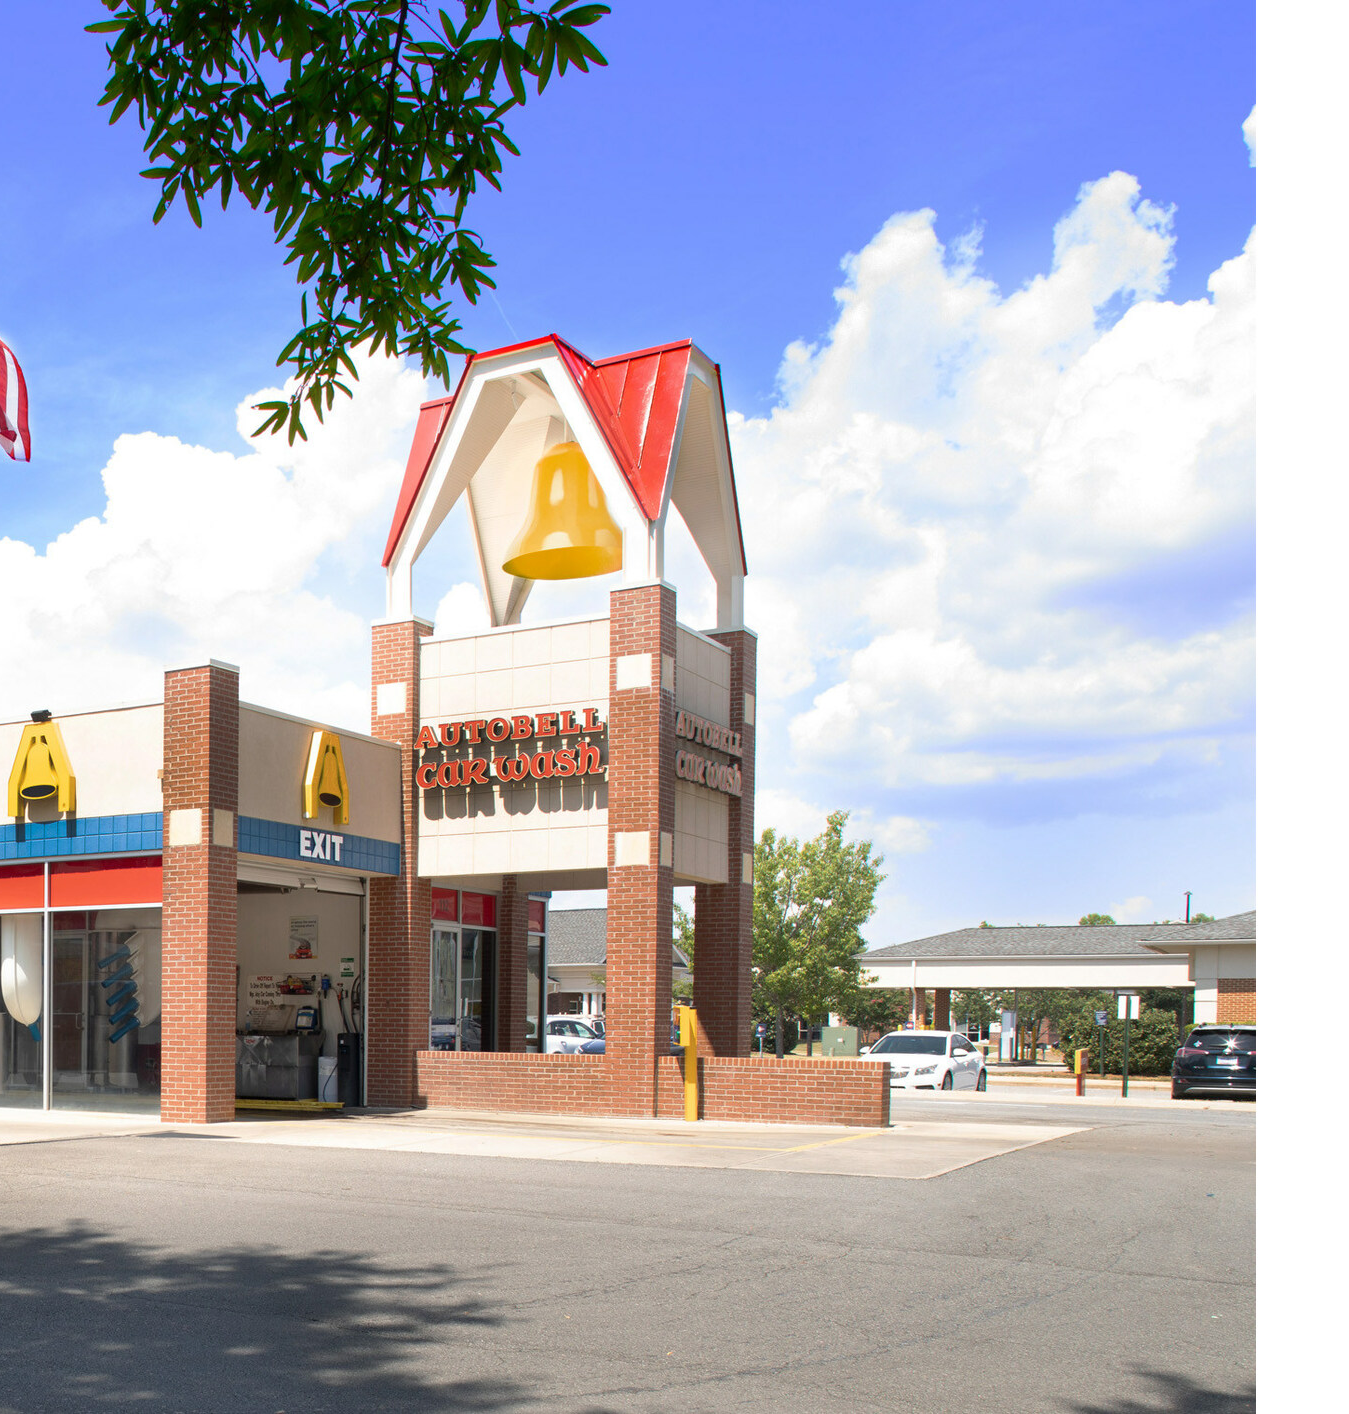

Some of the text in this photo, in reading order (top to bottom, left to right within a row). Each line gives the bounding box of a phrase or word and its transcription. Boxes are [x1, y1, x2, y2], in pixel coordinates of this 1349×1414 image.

[414, 708, 604, 749] AUTOBELL
[676, 710, 742, 758] AUTOBELL
[300, 829, 344, 862] EXIT
